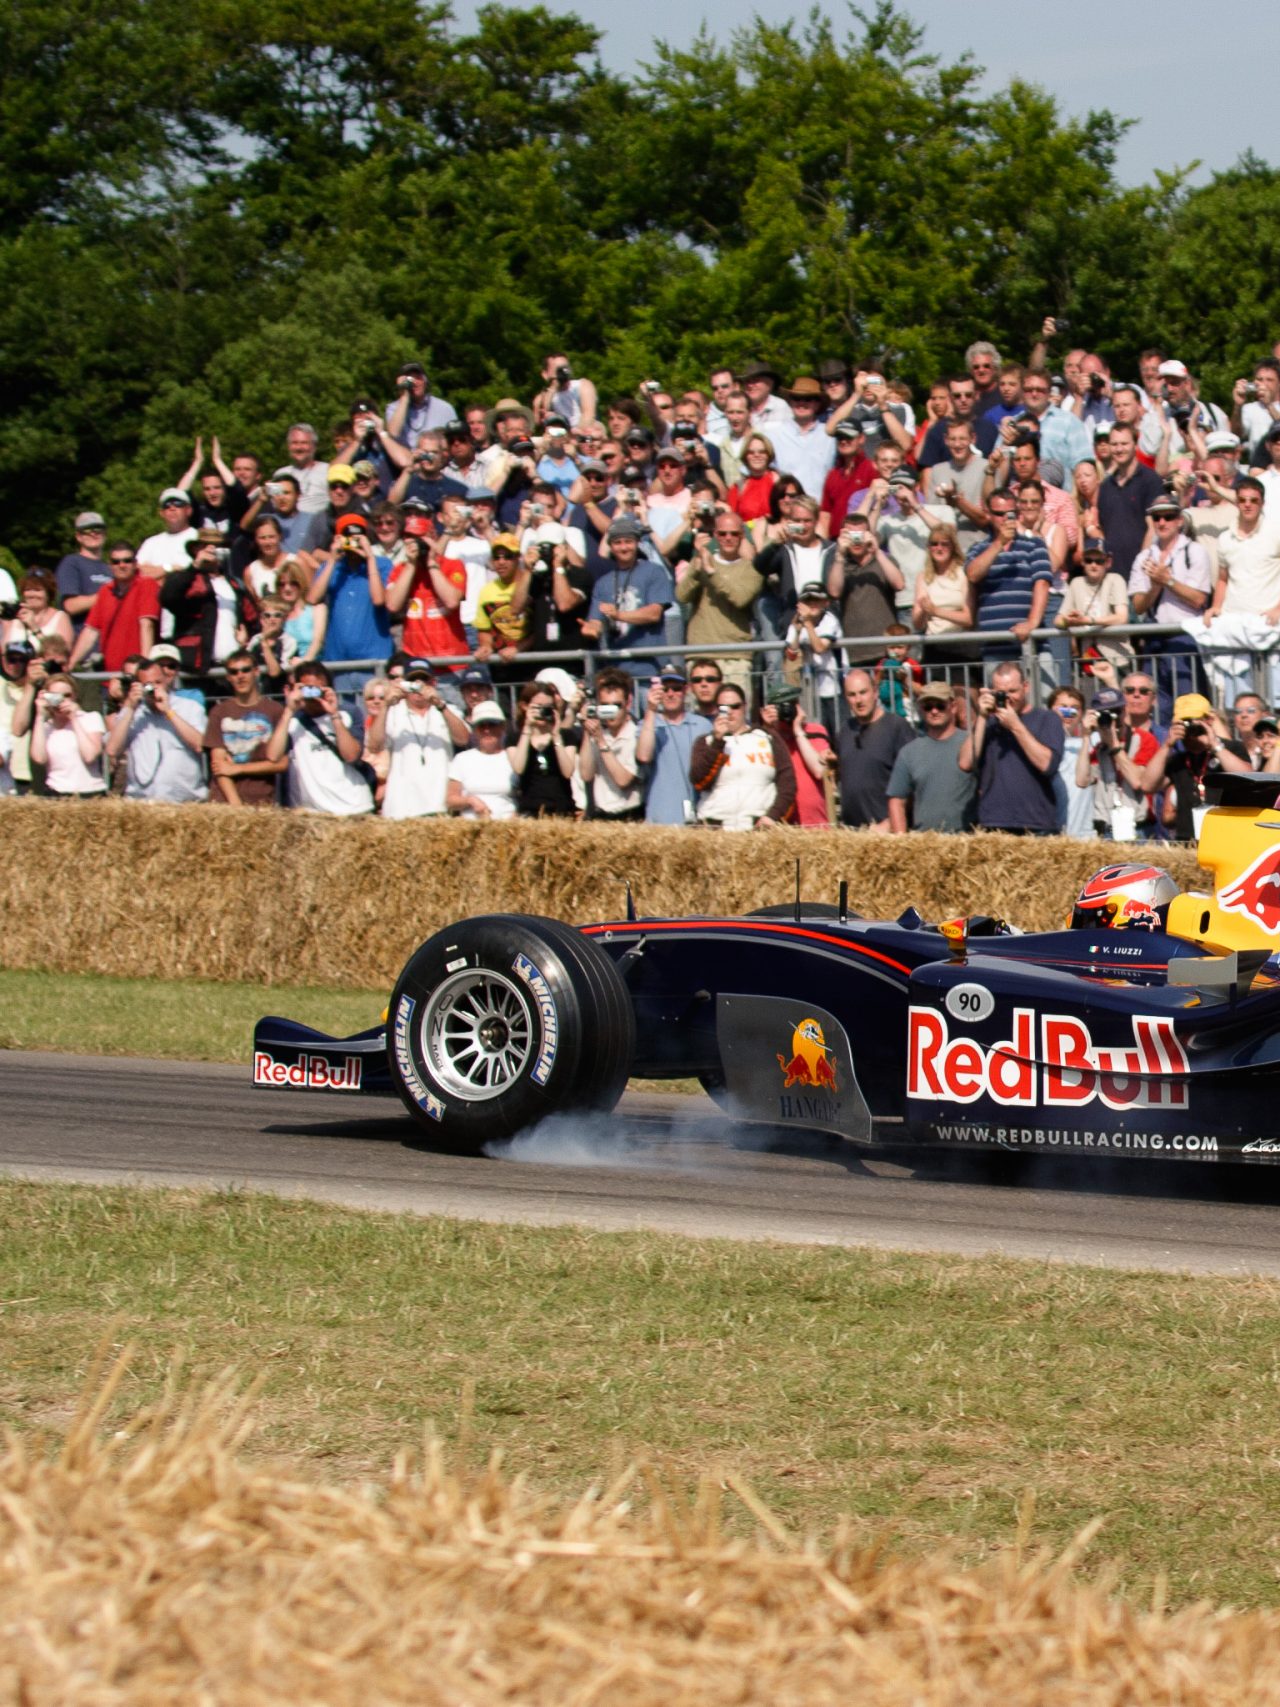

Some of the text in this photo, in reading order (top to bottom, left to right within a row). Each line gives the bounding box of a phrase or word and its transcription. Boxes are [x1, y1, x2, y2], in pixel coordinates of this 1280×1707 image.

[1113, 947, 1143, 956] LIUZZI
[958, 992, 981, 1012] 90
[530, 976, 558, 1084] MICHELIN
[395, 996, 425, 1100] MICHELIN
[908, 1009, 1187, 1106] Red Bull
[255, 1053, 361, 1088] Red Bull
[936, 1126, 1219, 1152] WWW.REDBULLRACING.COM
